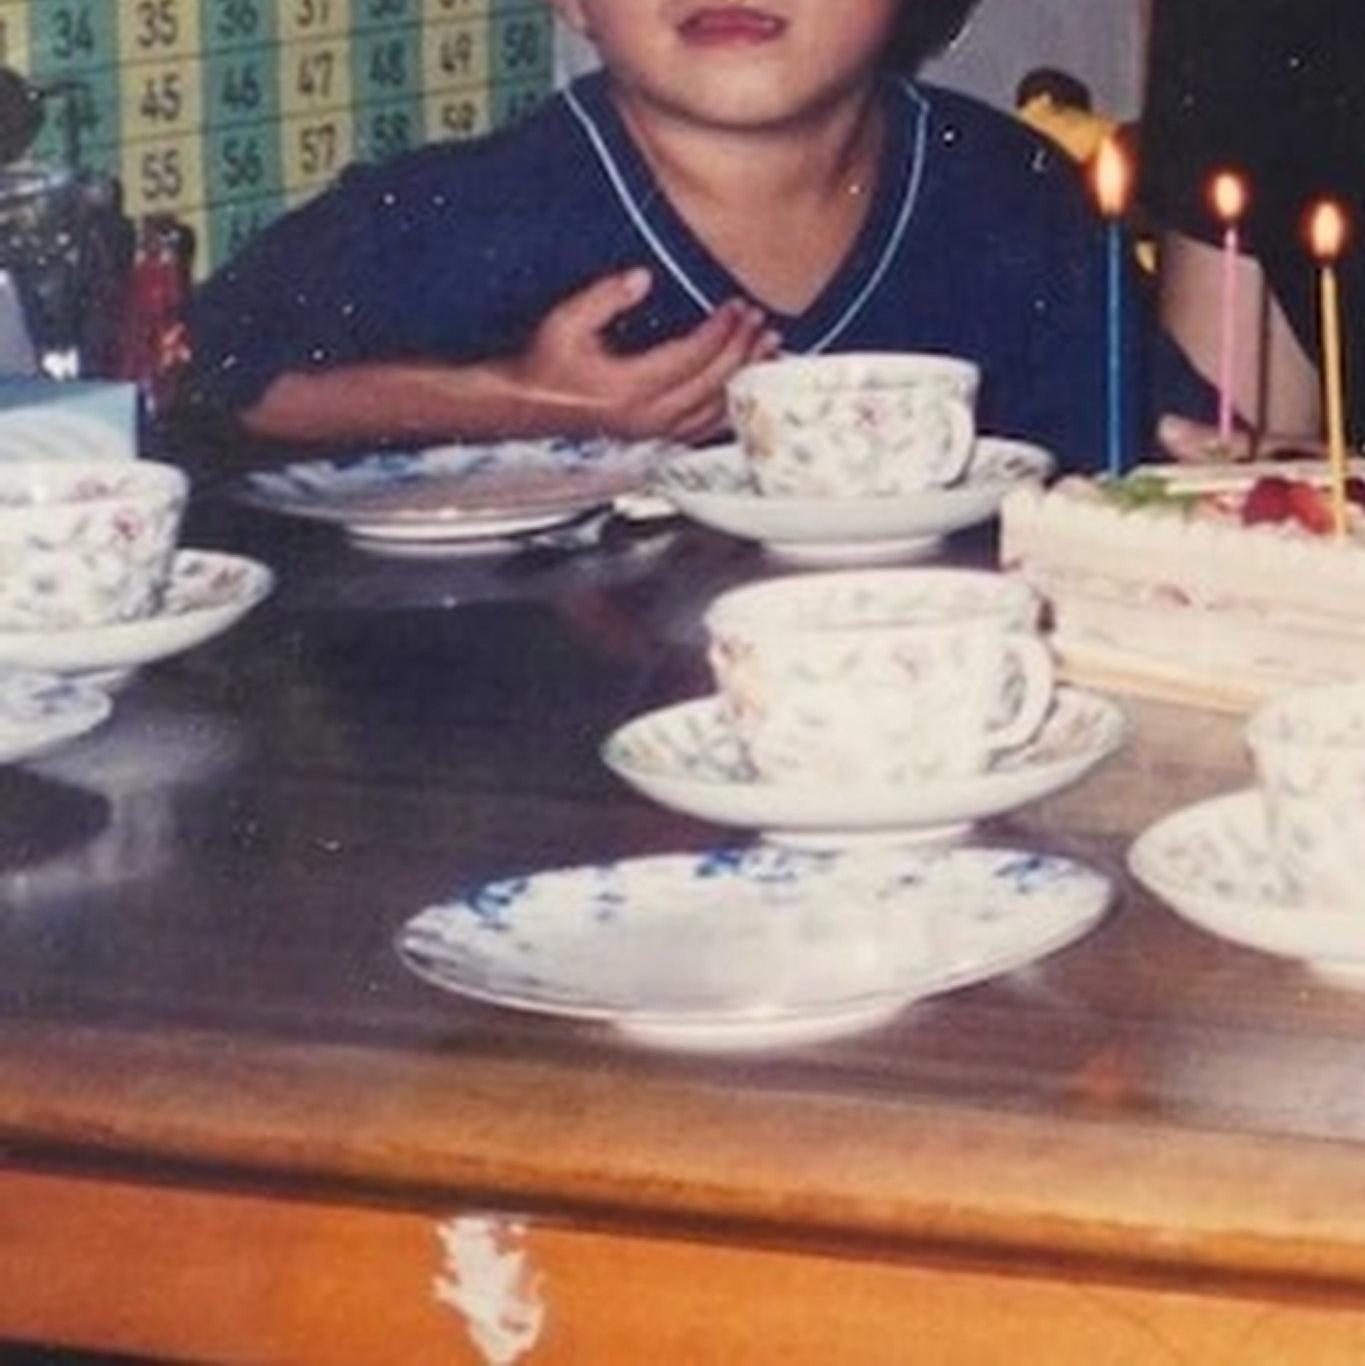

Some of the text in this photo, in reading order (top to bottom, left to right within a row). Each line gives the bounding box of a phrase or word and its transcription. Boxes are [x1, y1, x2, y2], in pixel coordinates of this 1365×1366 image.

[141, 72, 181, 122] 45
[298, 50, 335, 98] 47
[440, 33, 472, 74] 49
[142, 149, 182, 200] 55
[222, 138, 262, 188] 56
[301, 123, 336, 174] 57
